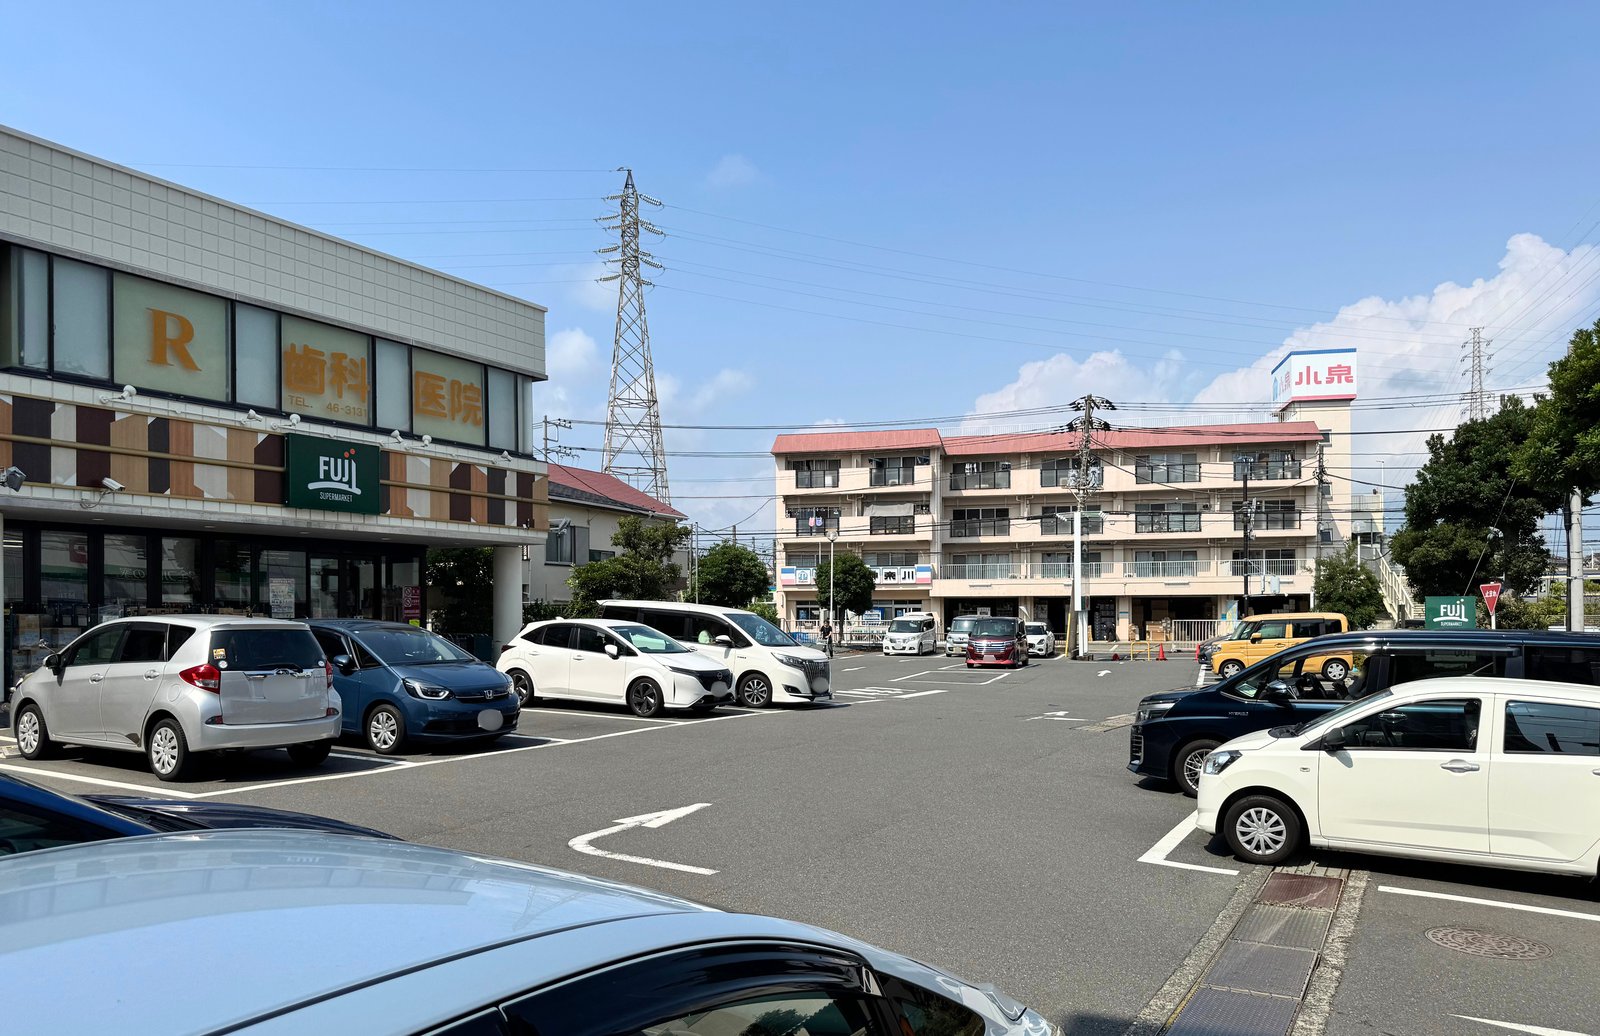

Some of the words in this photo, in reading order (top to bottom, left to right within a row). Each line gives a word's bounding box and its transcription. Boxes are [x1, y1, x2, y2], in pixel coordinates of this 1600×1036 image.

[147, 307, 202, 373] R
[283, 342, 371, 403] 歯科
[414, 370, 483, 427] 医院
[1295, 364, 1353, 386] 小泉
[287, 395, 313, 410] TEL.
[319, 491, 353, 503] SUPERMARKET
